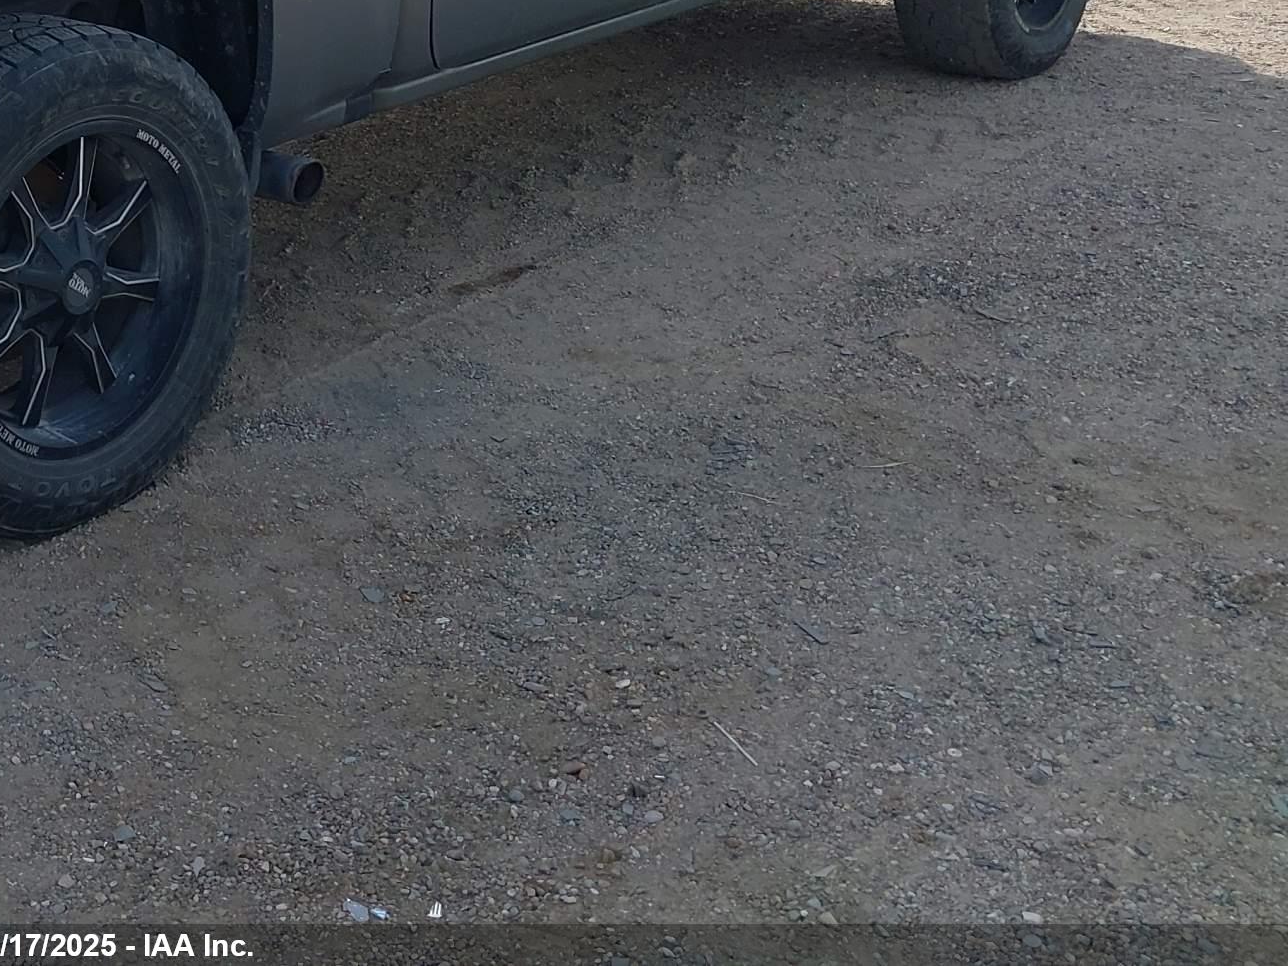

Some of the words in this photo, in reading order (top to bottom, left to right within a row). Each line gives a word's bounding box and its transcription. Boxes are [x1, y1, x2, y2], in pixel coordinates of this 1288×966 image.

[136, 128, 160, 149] MOTO
[158, 144, 181, 174] METAL
[14, 438, 40, 457] MOTO
